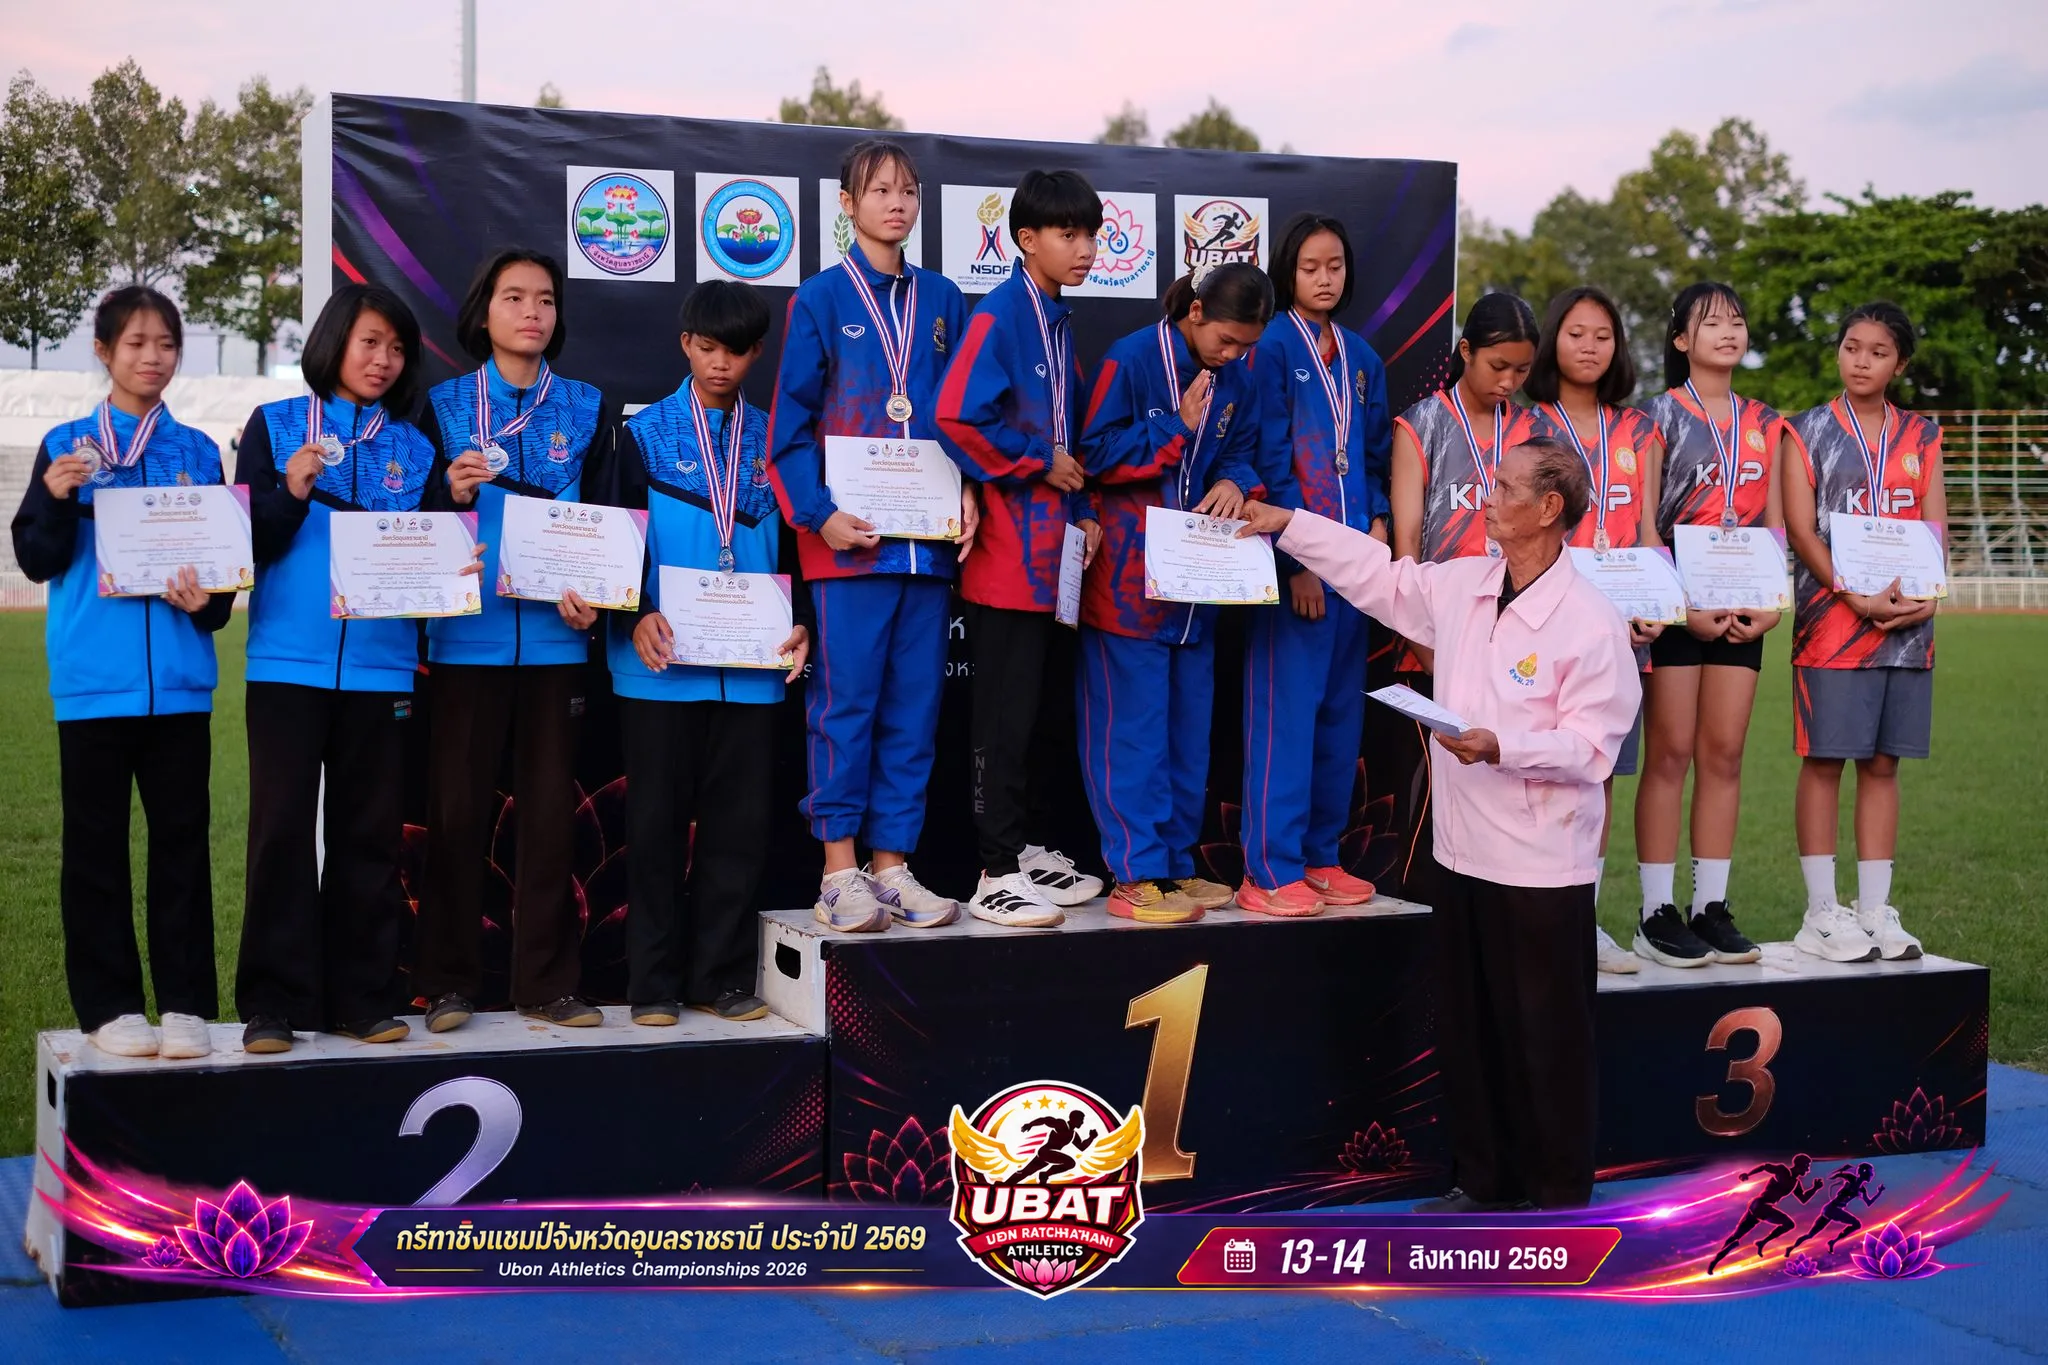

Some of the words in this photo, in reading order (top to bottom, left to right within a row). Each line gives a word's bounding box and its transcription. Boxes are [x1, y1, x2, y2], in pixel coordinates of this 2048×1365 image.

[970, 264, 1011, 275] NSDF
[1189, 249, 1255, 267] UBAT
[974, 755, 985, 814] NIKE
[1125, 965, 1208, 1182] 1
[1696, 1006, 1782, 1136] 3
[399, 1076, 523, 1207] 2
